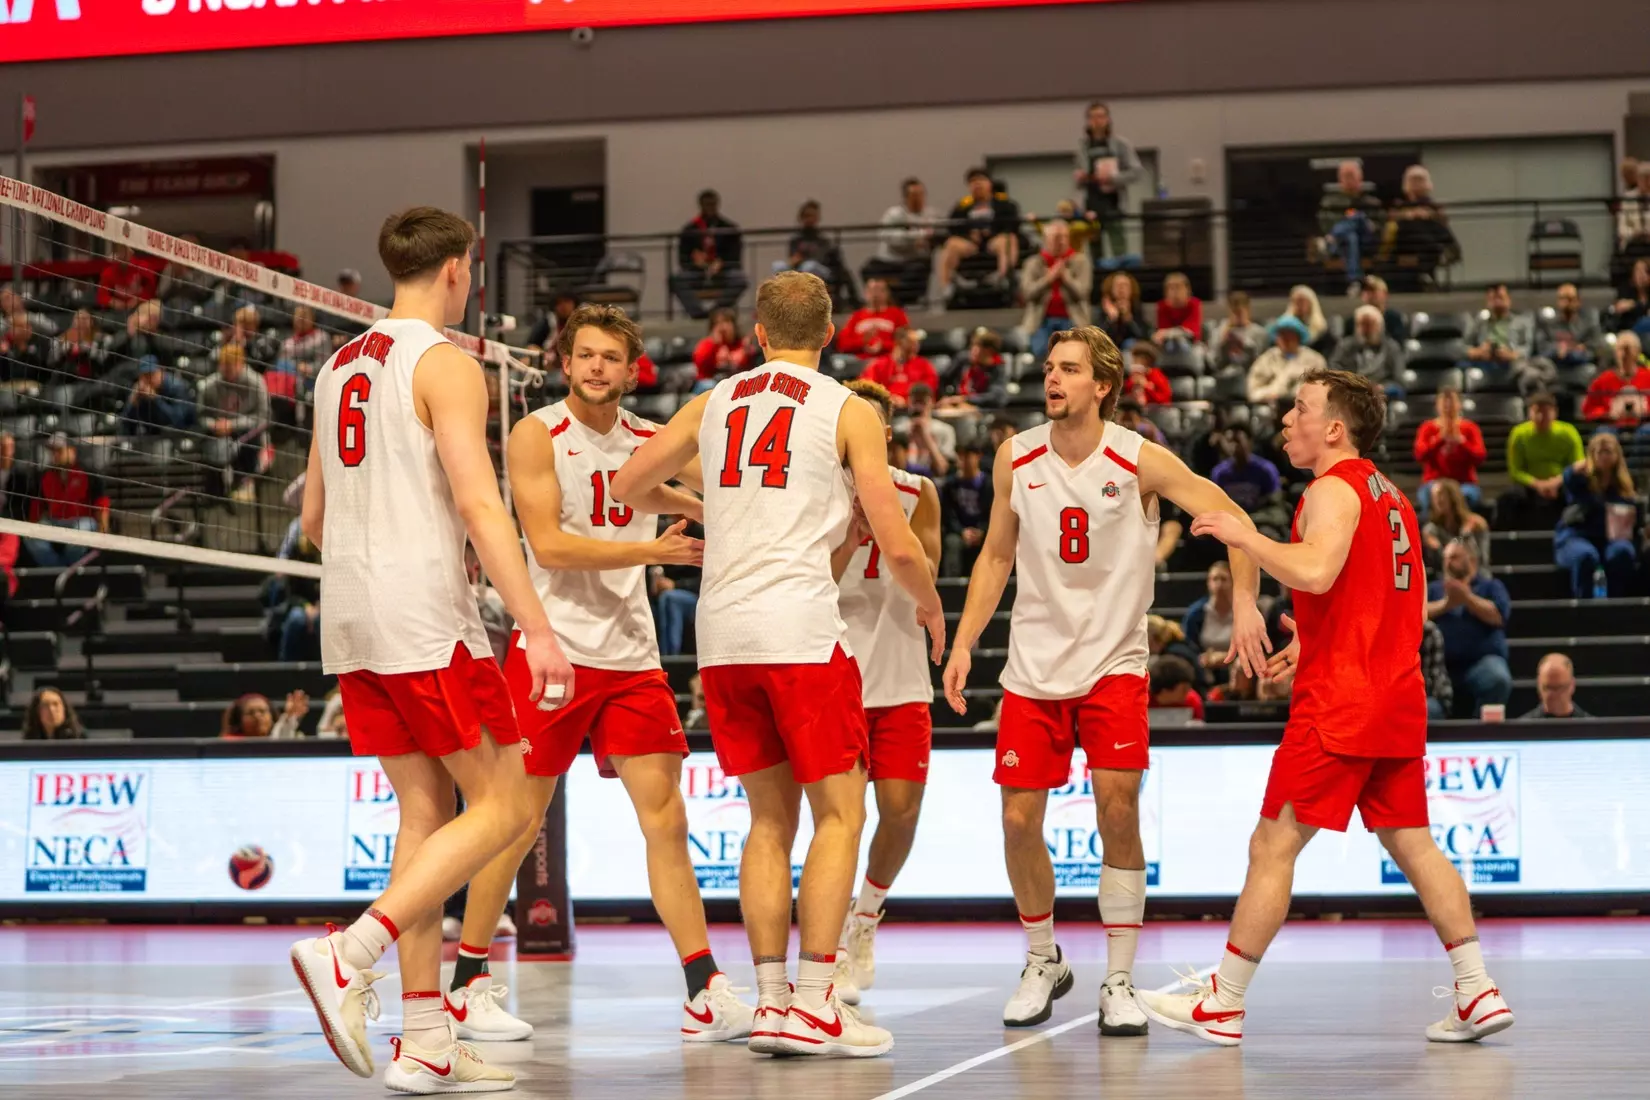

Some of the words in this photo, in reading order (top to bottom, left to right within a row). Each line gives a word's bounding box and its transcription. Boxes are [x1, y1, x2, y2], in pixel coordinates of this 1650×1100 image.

[0, 178, 31, 204] EE-TIME
[31, 187, 65, 217] NATIONAL
[66, 200, 106, 231] CHAMPIONS
[730, 372, 772, 402] OHIO
[769, 371, 812, 406] STATE
[337, 372, 371, 467] 6
[719, 404, 796, 489] 14
[590, 470, 634, 527] 15
[1059, 506, 1090, 564] 8
[1387, 507, 1412, 591] 2
[34, 772, 145, 807] IBEW
[352, 769, 396, 803] IB
[33, 835, 132, 867] NECA
[350, 833, 396, 865] NE
